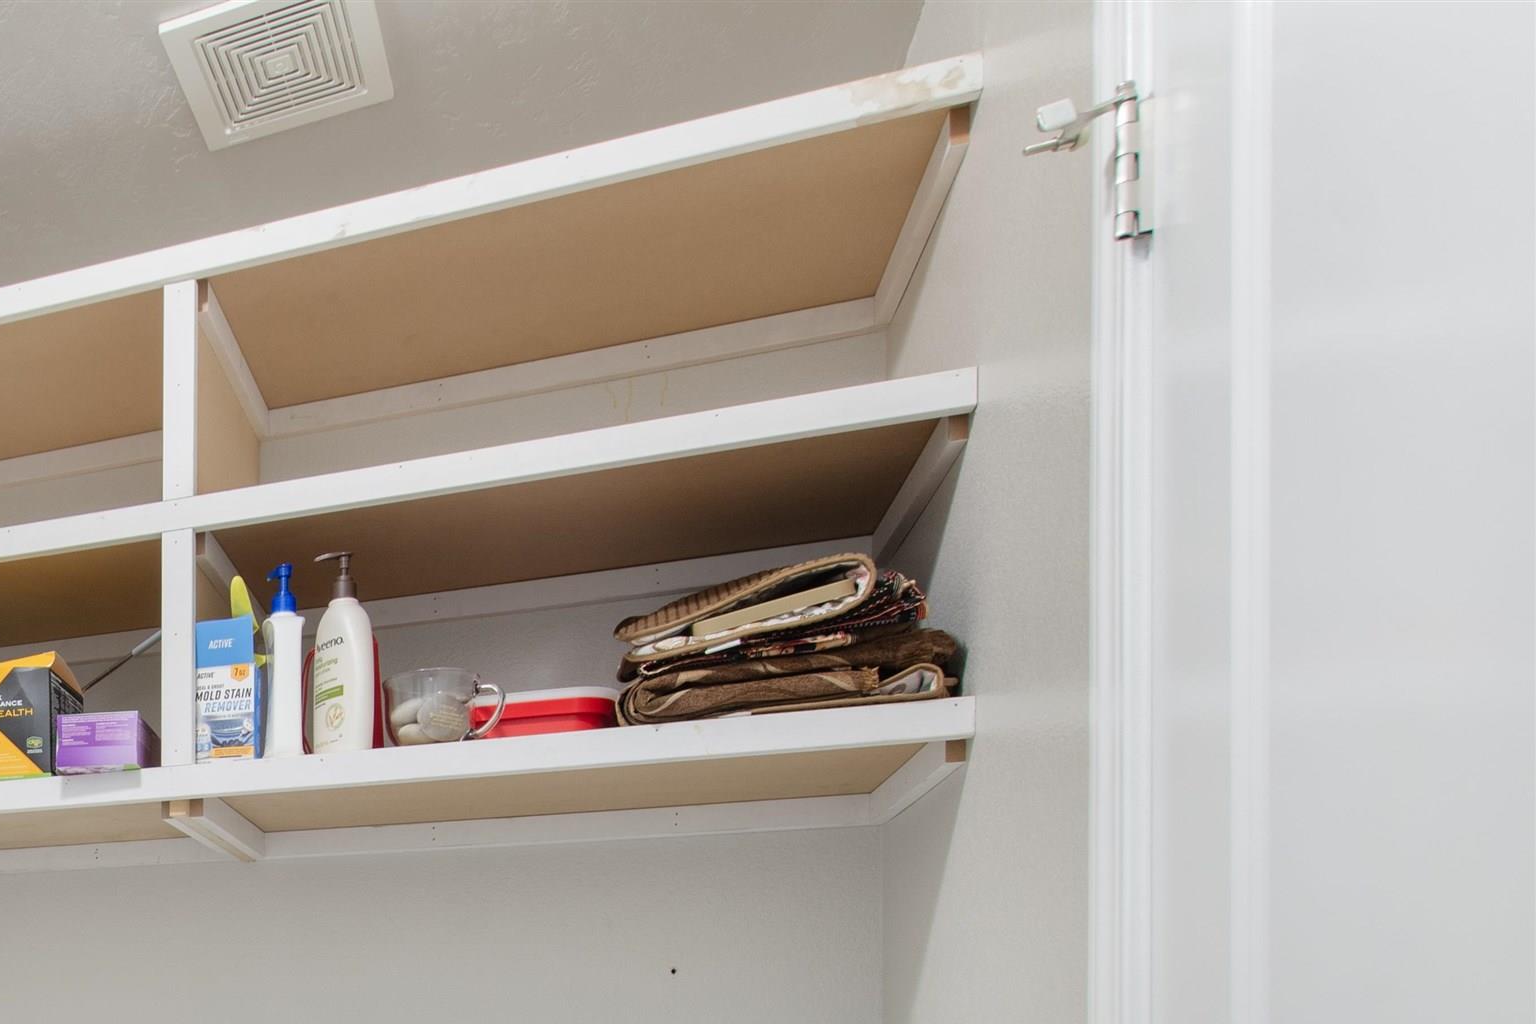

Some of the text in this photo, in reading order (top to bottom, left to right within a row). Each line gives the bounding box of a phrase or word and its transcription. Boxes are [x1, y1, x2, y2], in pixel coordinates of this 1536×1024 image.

[208, 638, 233, 650] ACTIVE
[195, 688, 252, 703] MOLD STAIN
[204, 700, 251, 714] REMOVER
